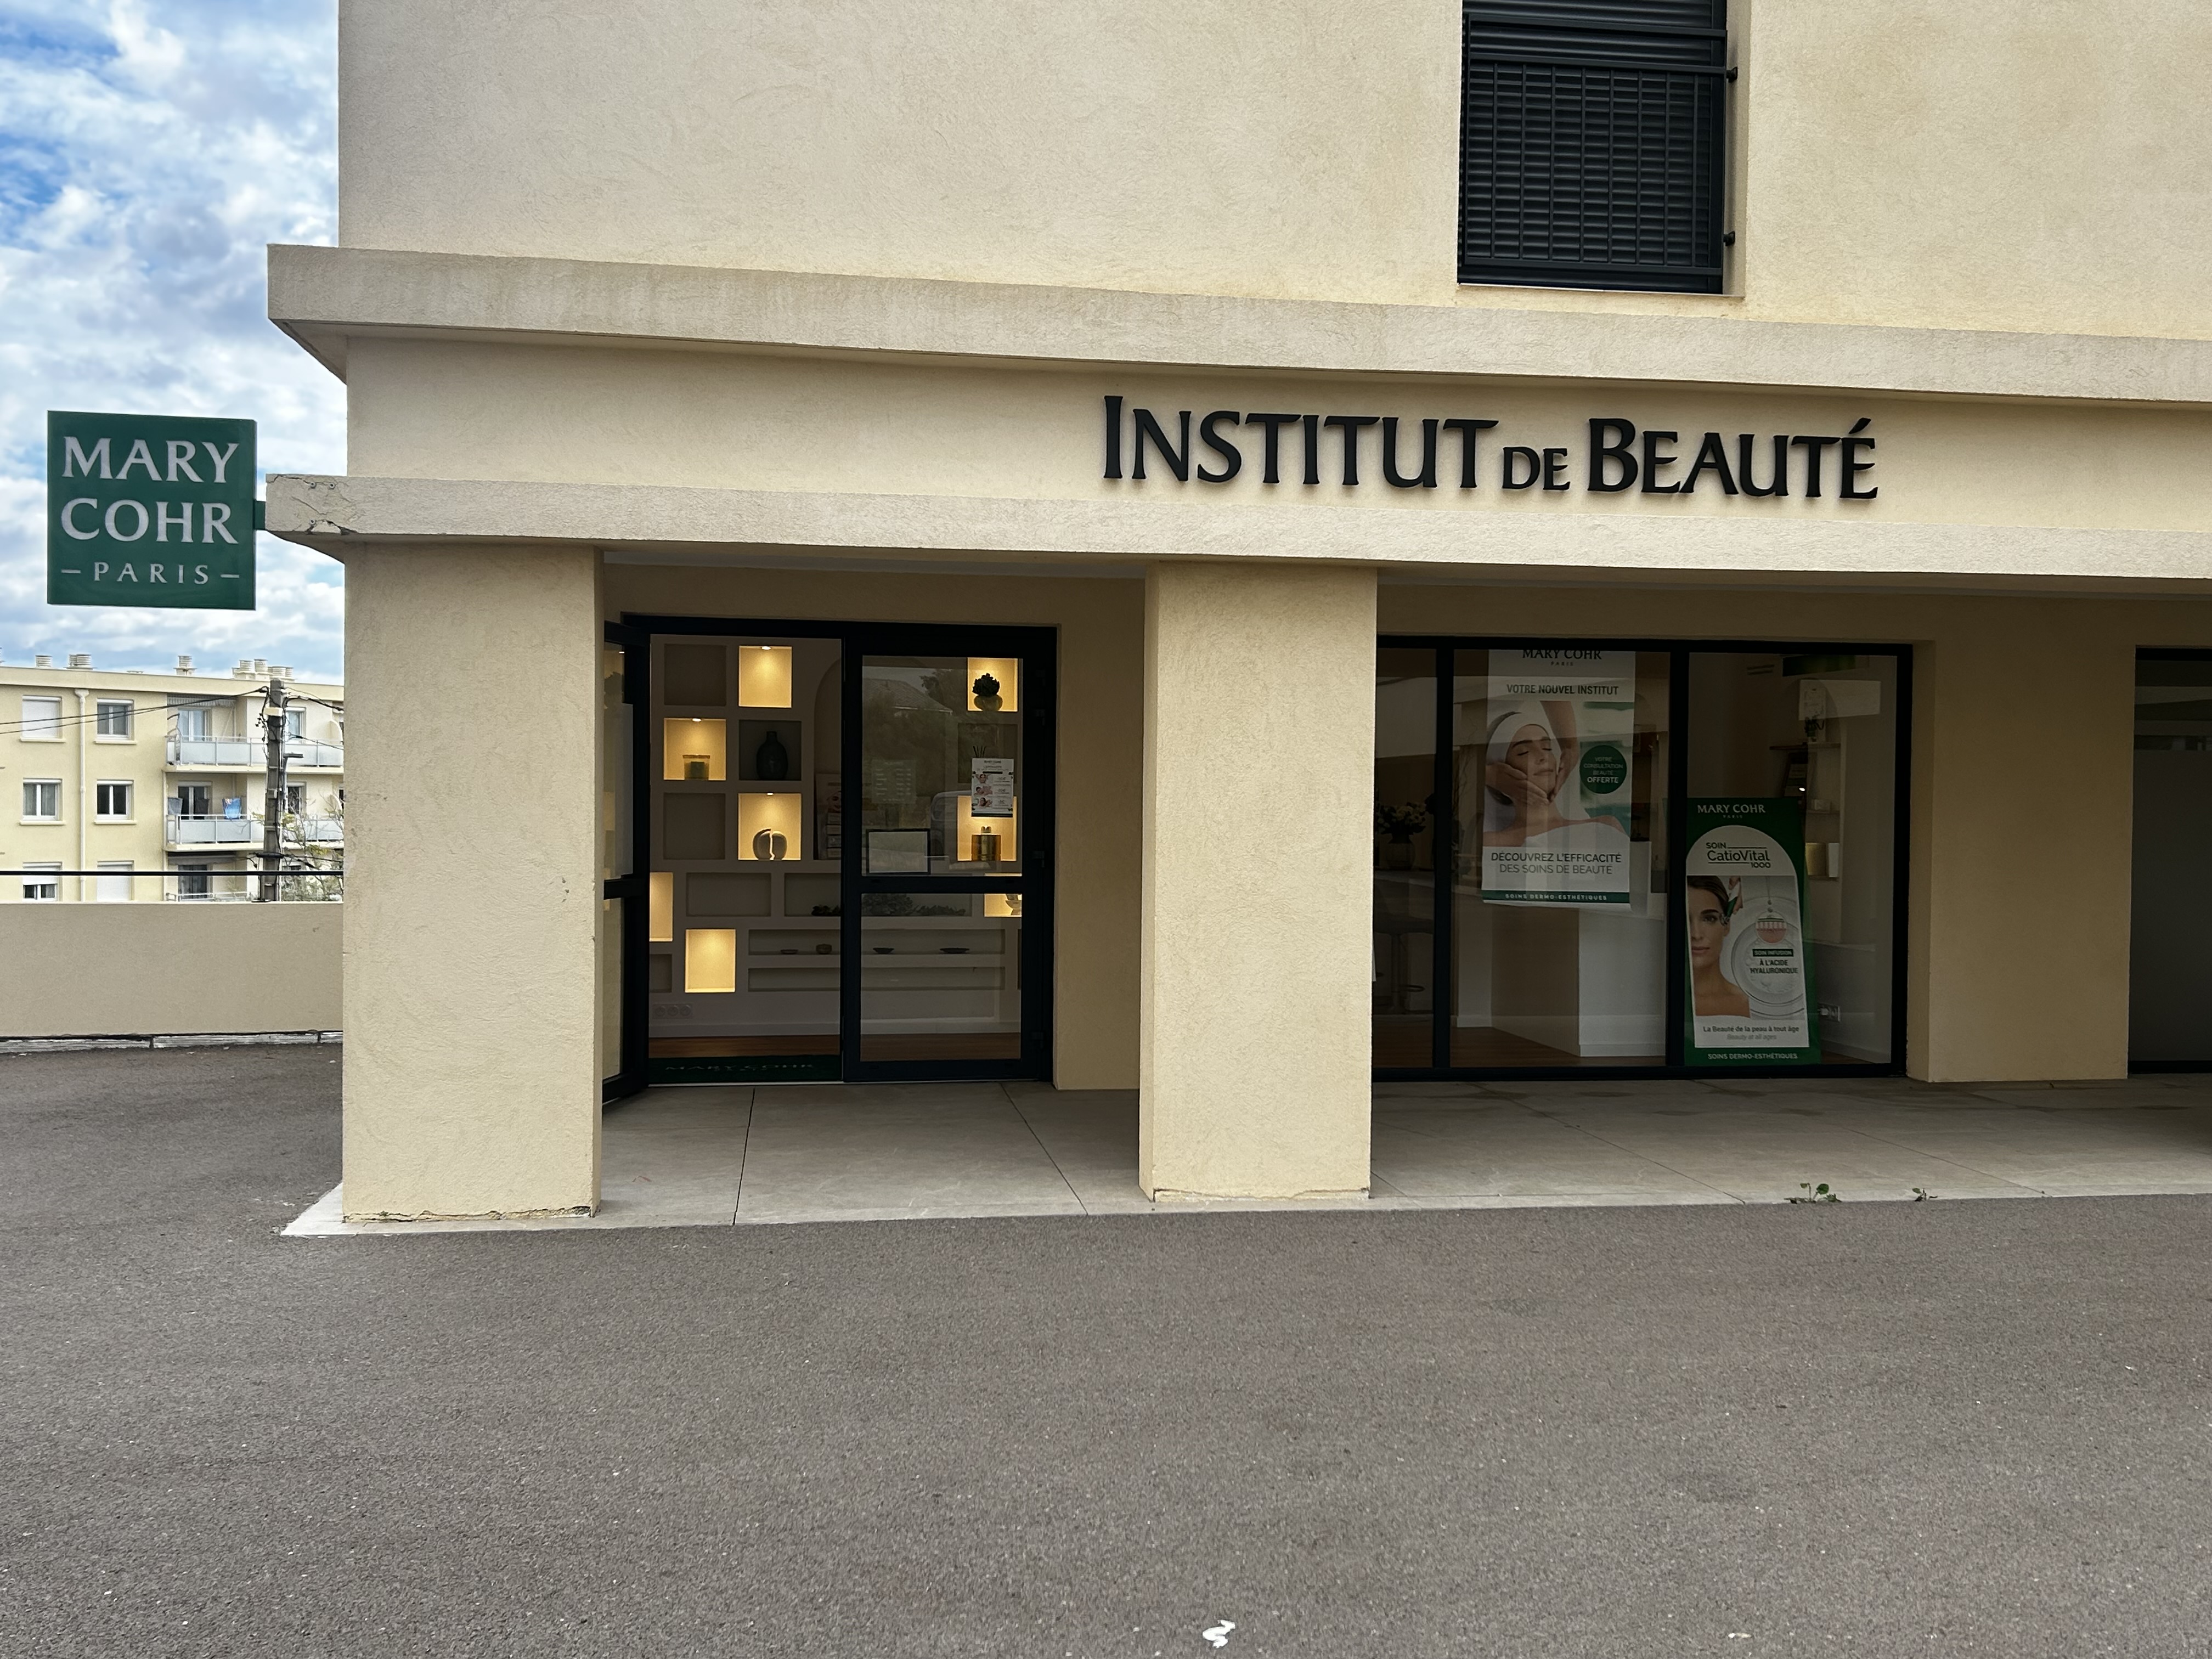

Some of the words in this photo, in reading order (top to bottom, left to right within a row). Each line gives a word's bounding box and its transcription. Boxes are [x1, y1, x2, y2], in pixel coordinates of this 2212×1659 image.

[1103, 396, 1499, 488] INSTITUT
[1502, 447, 1571, 491] DE
[1587, 417, 1878, 499] BEAUTÉ
[62, 436, 239, 483] MARY
[61, 498, 239, 544] COHR
[94, 561, 209, 585] PARIS
[1522, 650, 1560, 658] MARY
[1564, 650, 1602, 659] COHR
[1506, 684, 1536, 693] VOTRE
[1538, 685, 1576, 693] NOUVEL
[1578, 685, 1619, 695] INSTITUT
[1697, 804, 1730, 813] MARY
[1733, 804, 1767, 813] COHR
[1491, 851, 1554, 861] DÉCOUVREZ
[1556, 852, 1622, 862] L'EFFICACITÉ
[1707, 850, 1770, 861] CatioVital
[1499, 864, 1520, 873] DES
[1522, 865, 1554, 873] SOINS
[1556, 865, 1570, 873] DE
[1573, 864, 1613, 874] BEAUTÉ
